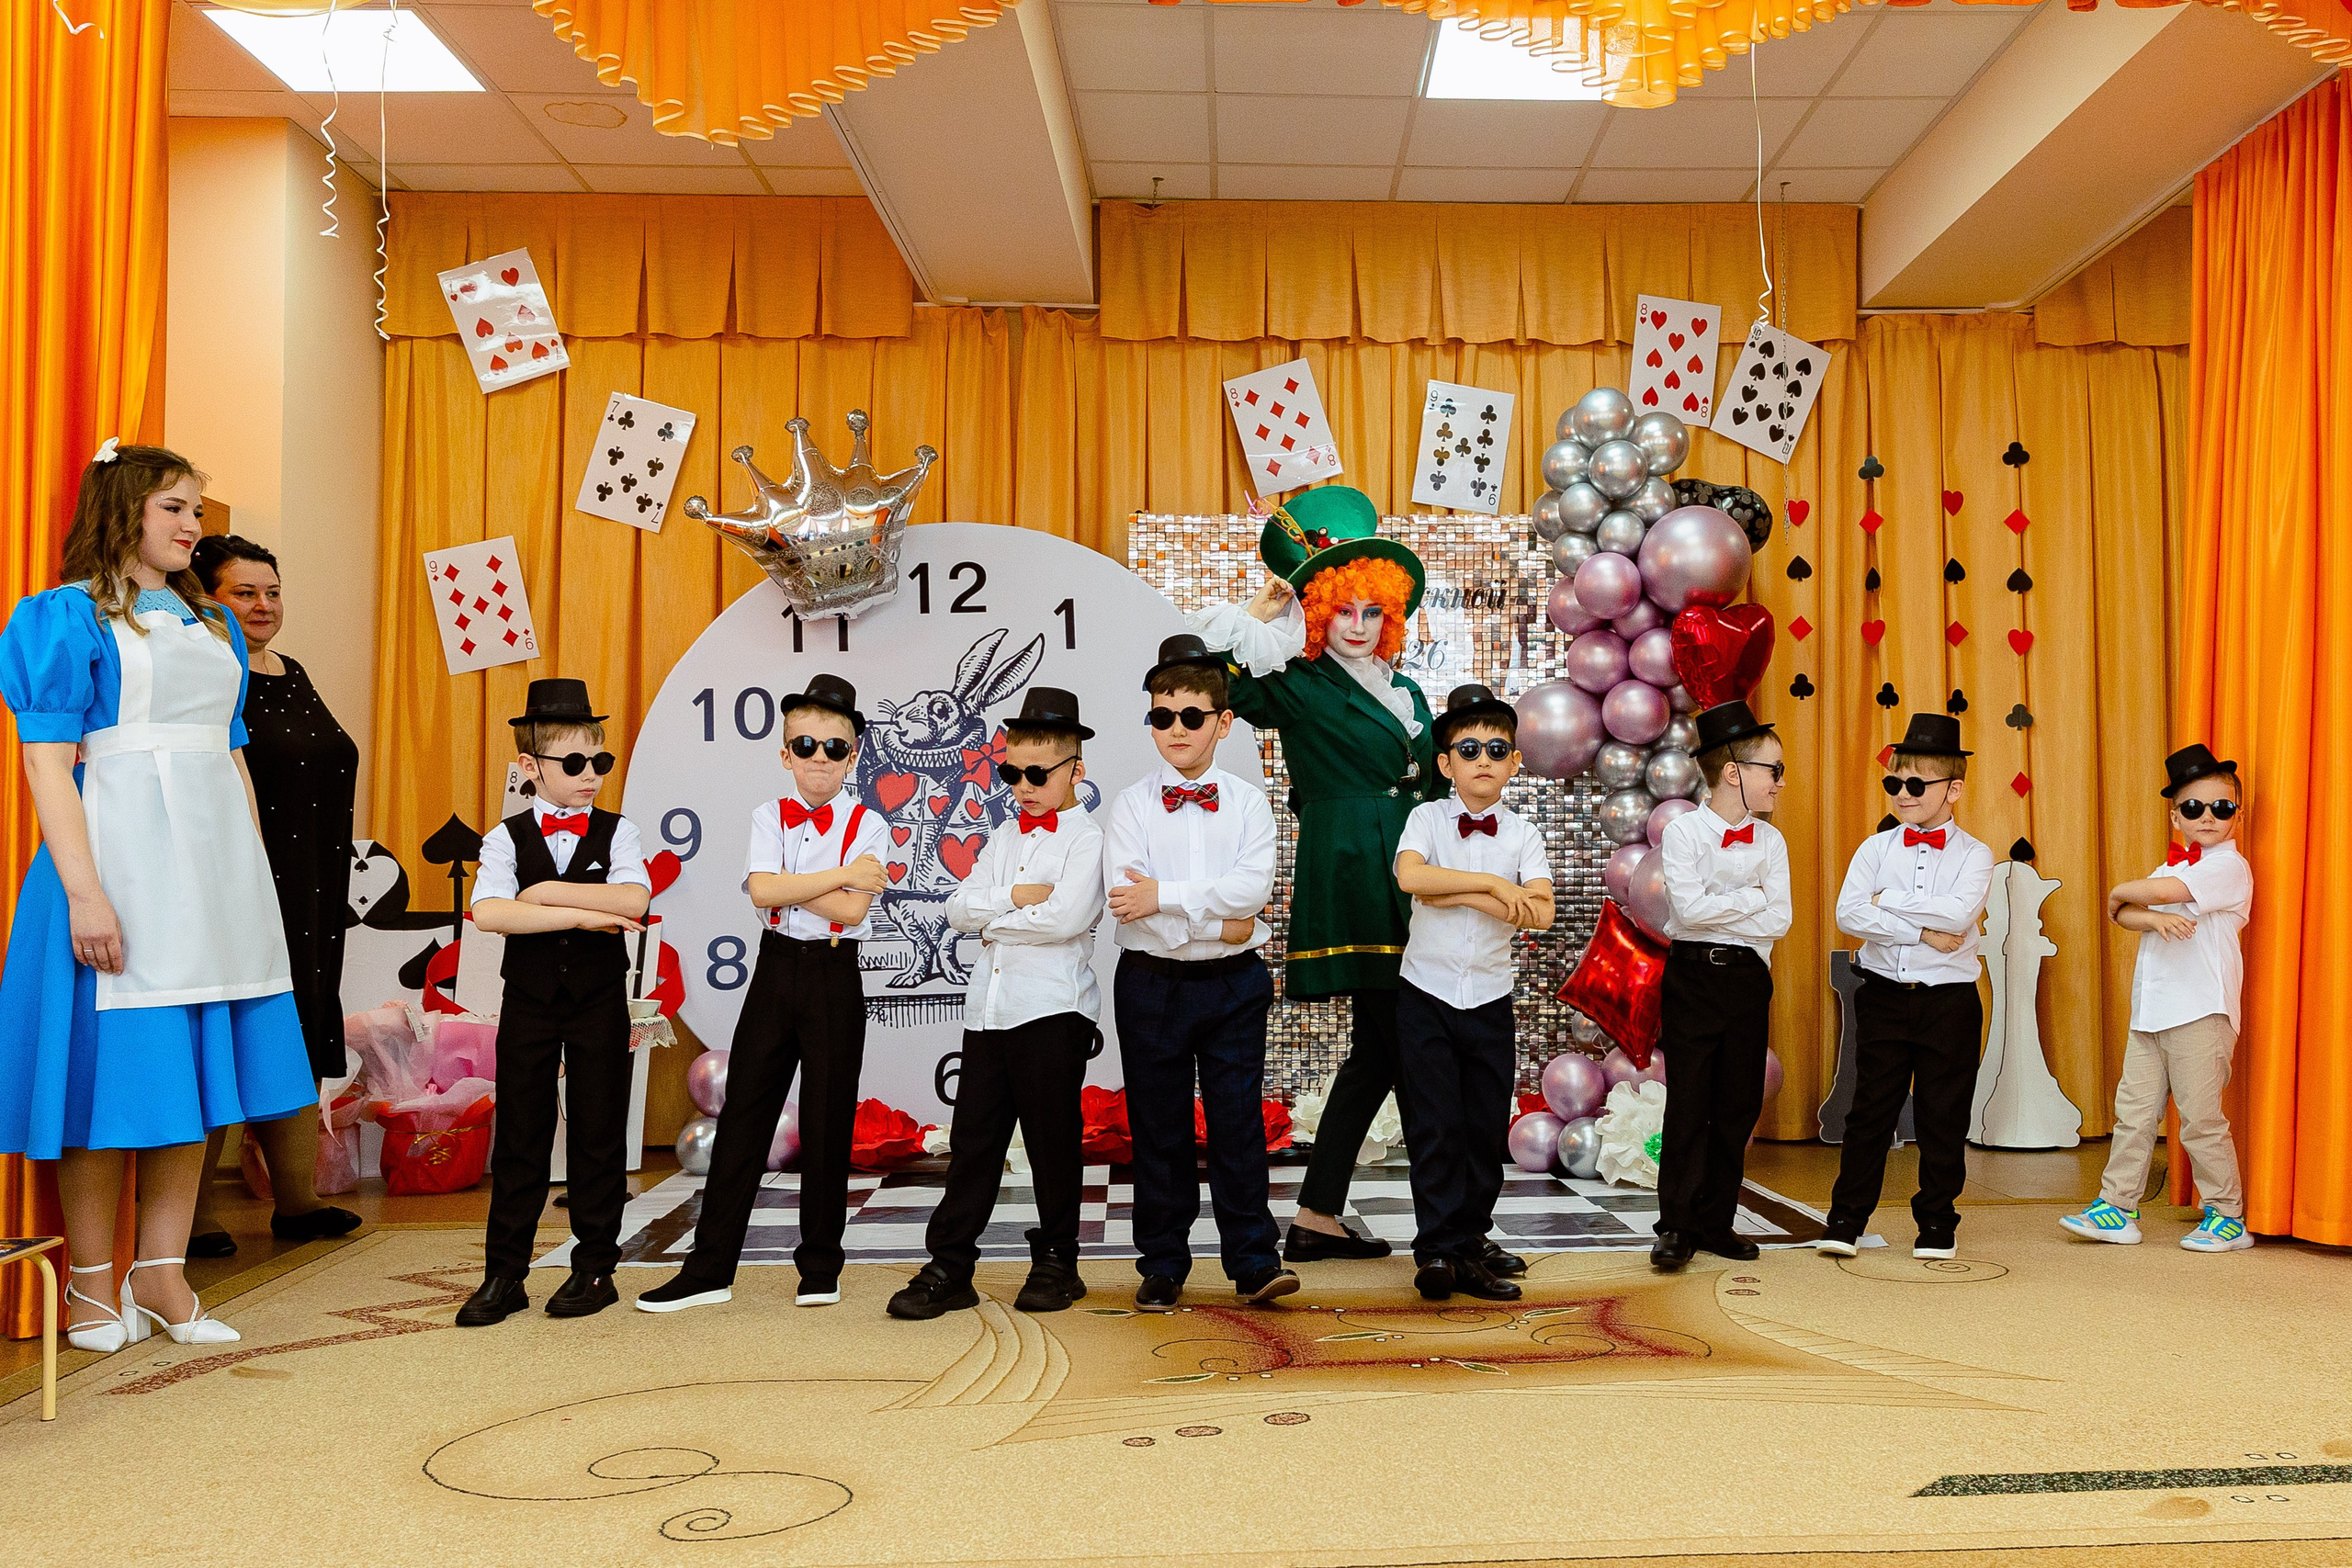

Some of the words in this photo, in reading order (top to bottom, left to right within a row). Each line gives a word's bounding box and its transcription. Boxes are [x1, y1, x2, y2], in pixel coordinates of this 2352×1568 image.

[1640, 303, 1648, 315] 8
[1229, 388, 1238, 400] 8
[1430, 389, 1439, 402] 9
[612, 400, 620, 412] 7
[1701, 405, 1709, 418] 8
[1327, 454, 1336, 467] 8
[429, 560, 438, 573] 9
[907, 561, 988, 615] 12
[1419, 579, 1508, 610] скной
[781, 604, 849, 653] 11
[1053, 598, 1077, 649] 1
[691, 686, 775, 742] 10
[509, 772, 518, 784] 8
[660, 807, 703, 863] 9
[706, 935, 749, 991] 8
